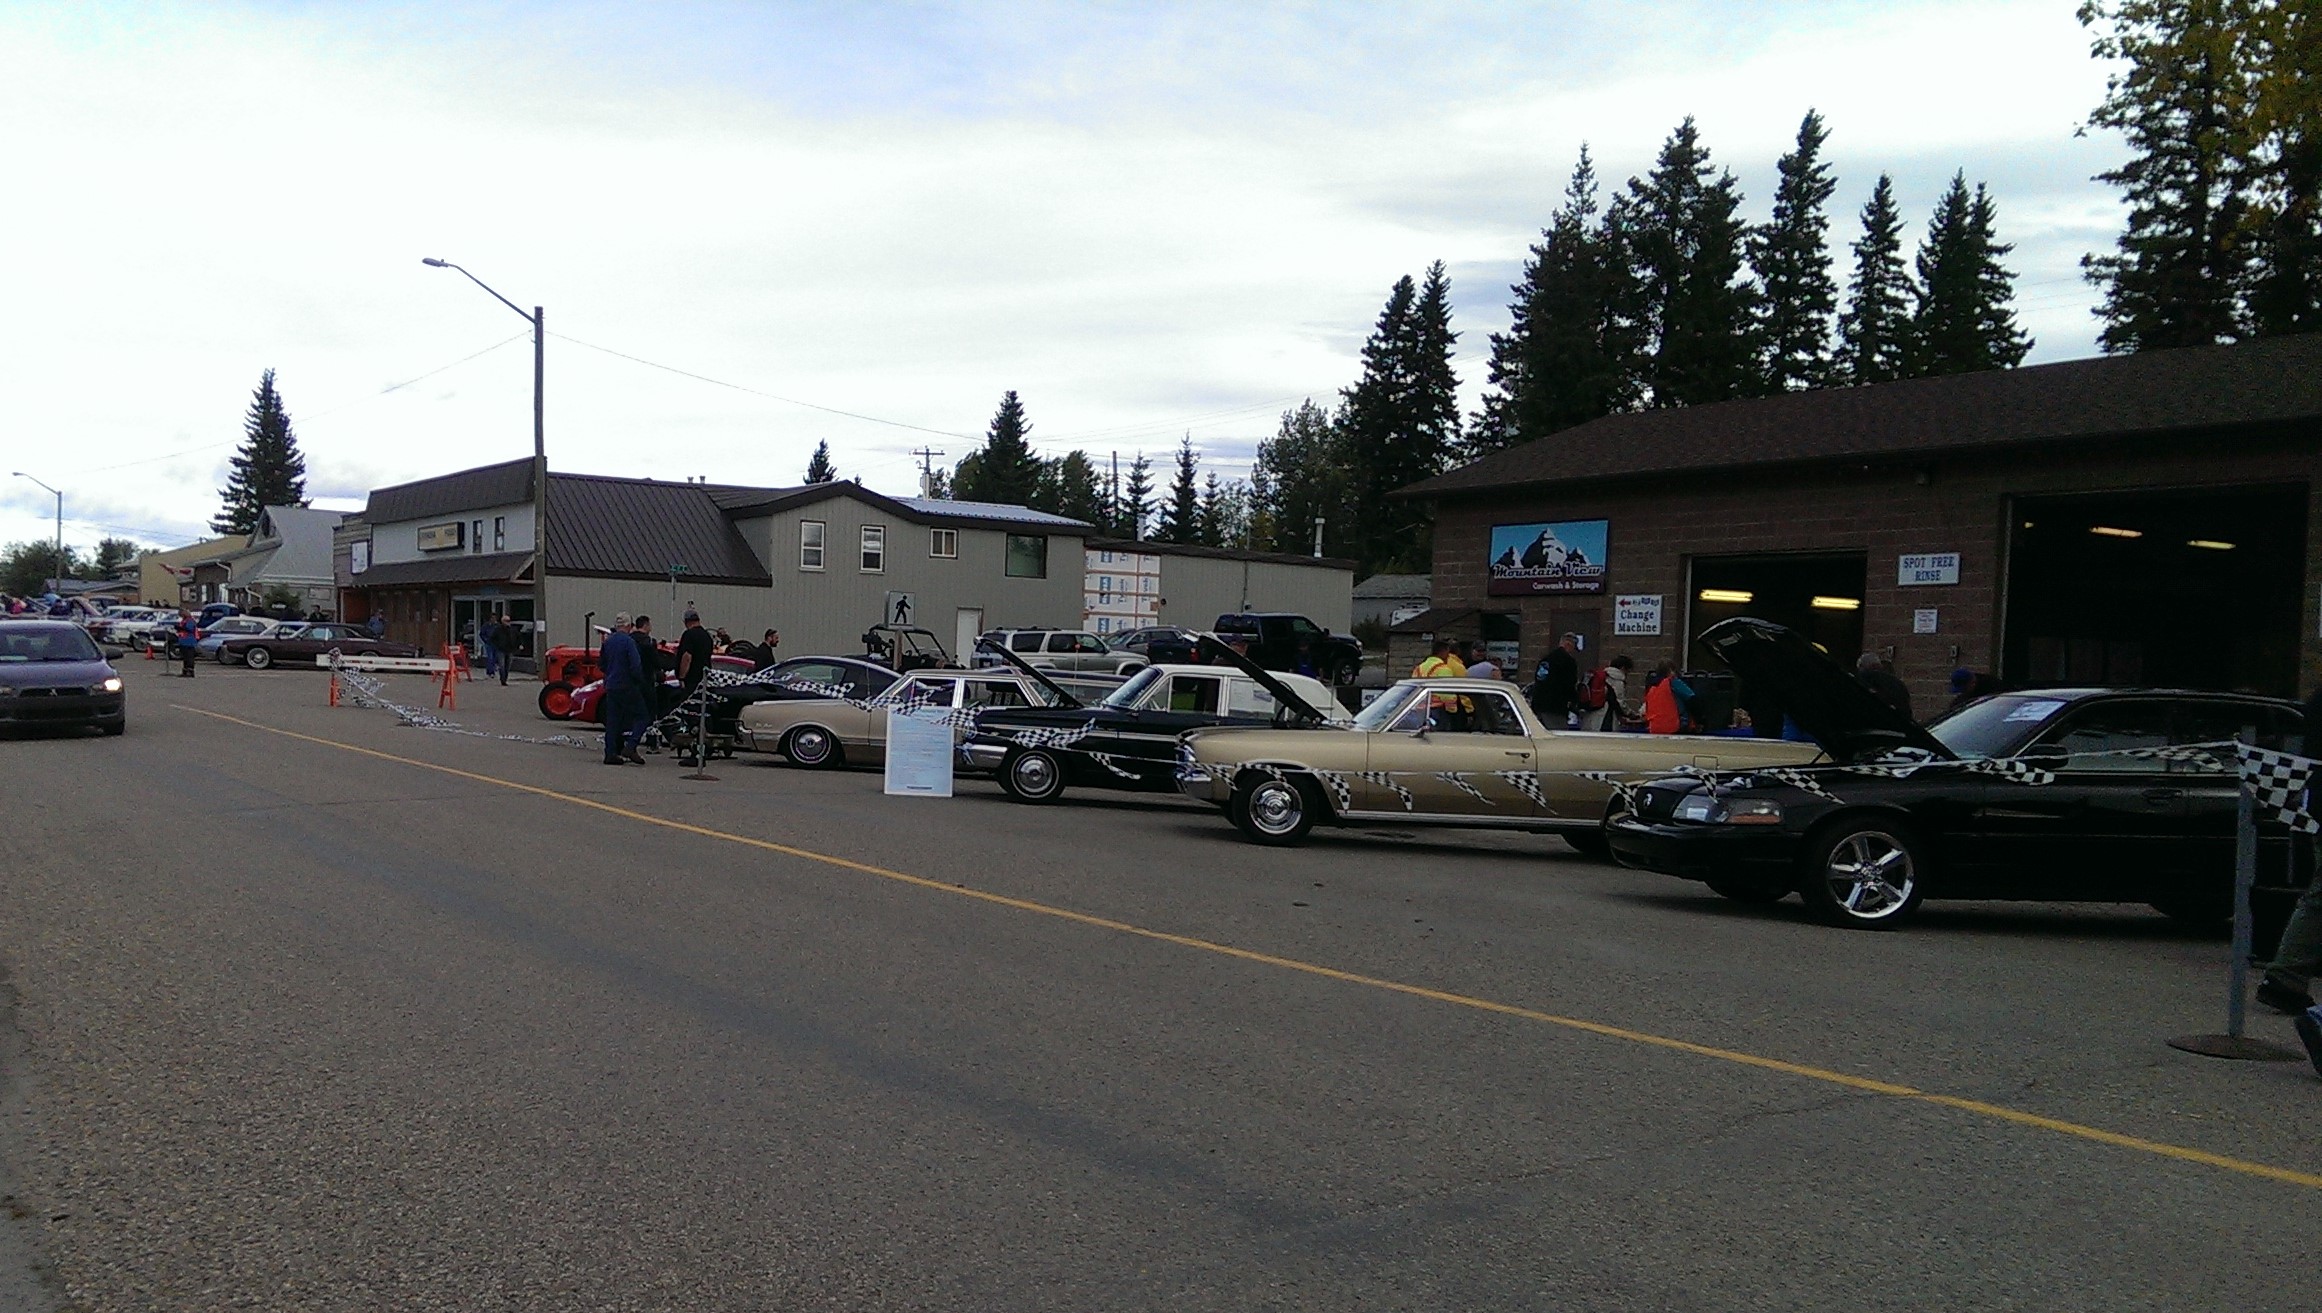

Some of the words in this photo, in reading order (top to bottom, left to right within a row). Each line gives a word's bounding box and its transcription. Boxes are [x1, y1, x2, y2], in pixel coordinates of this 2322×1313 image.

[1903, 557, 1926, 568] SPOT
[1931, 556, 1955, 568] FREE
[1493, 563, 1563, 579] Mountain
[1564, 559, 1601, 577] View
[1914, 570, 1941, 581] RINSE
[1532, 581, 1564, 590] Carwash
[1564, 581, 1571, 589] &
[1572, 581, 1600, 591] Storage
[1620, 609, 1655, 622] Change
[1618, 622, 1658, 632] Machine
